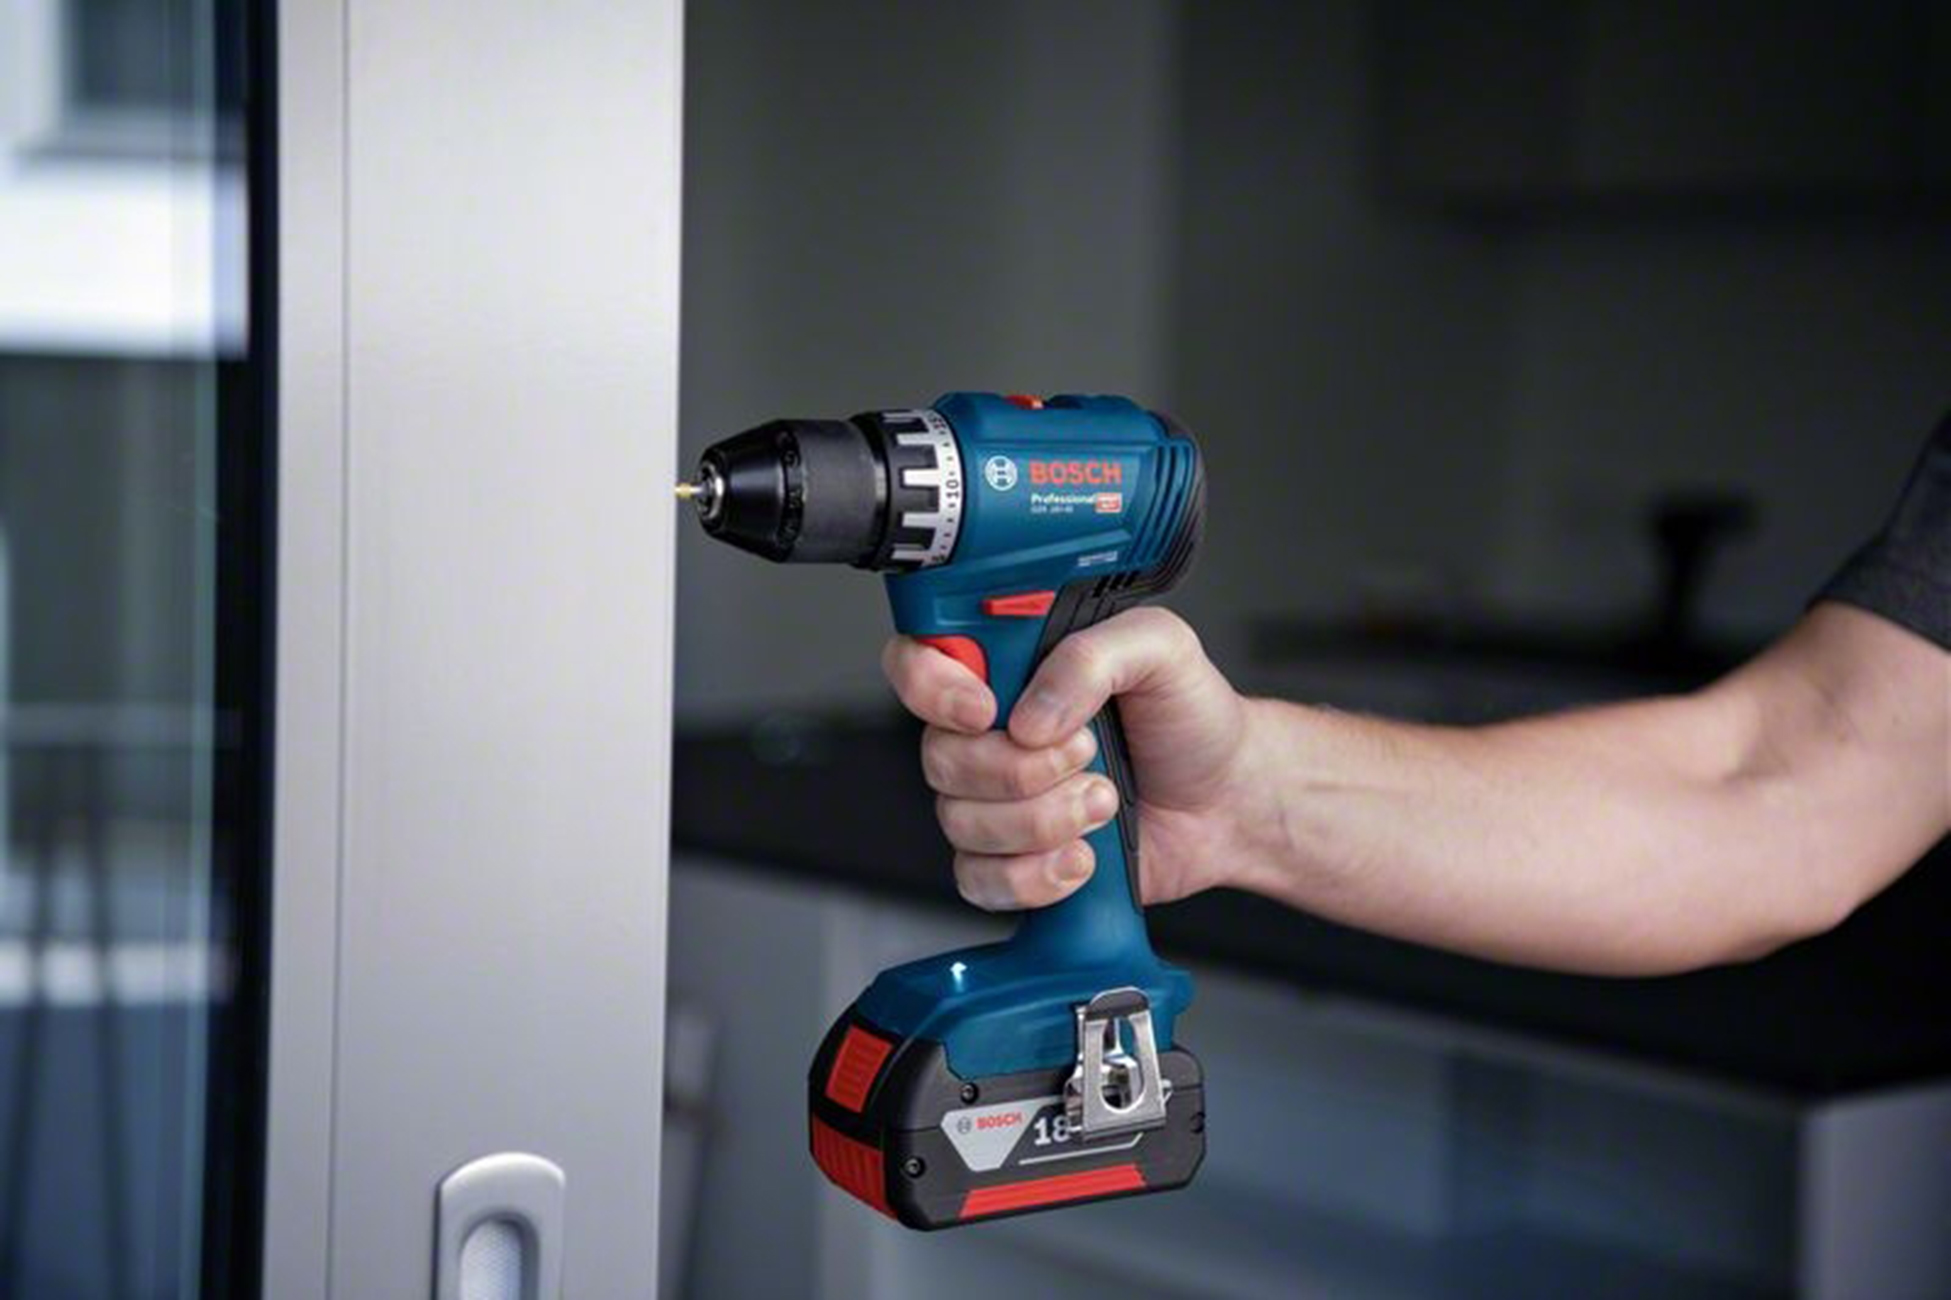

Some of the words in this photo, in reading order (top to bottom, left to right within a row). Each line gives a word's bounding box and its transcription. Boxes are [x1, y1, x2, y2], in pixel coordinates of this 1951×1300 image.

[1030, 460, 1122, 484] BOSCH
[945, 479, 960, 499] 10
[975, 1112, 1022, 1131] BOSCH
